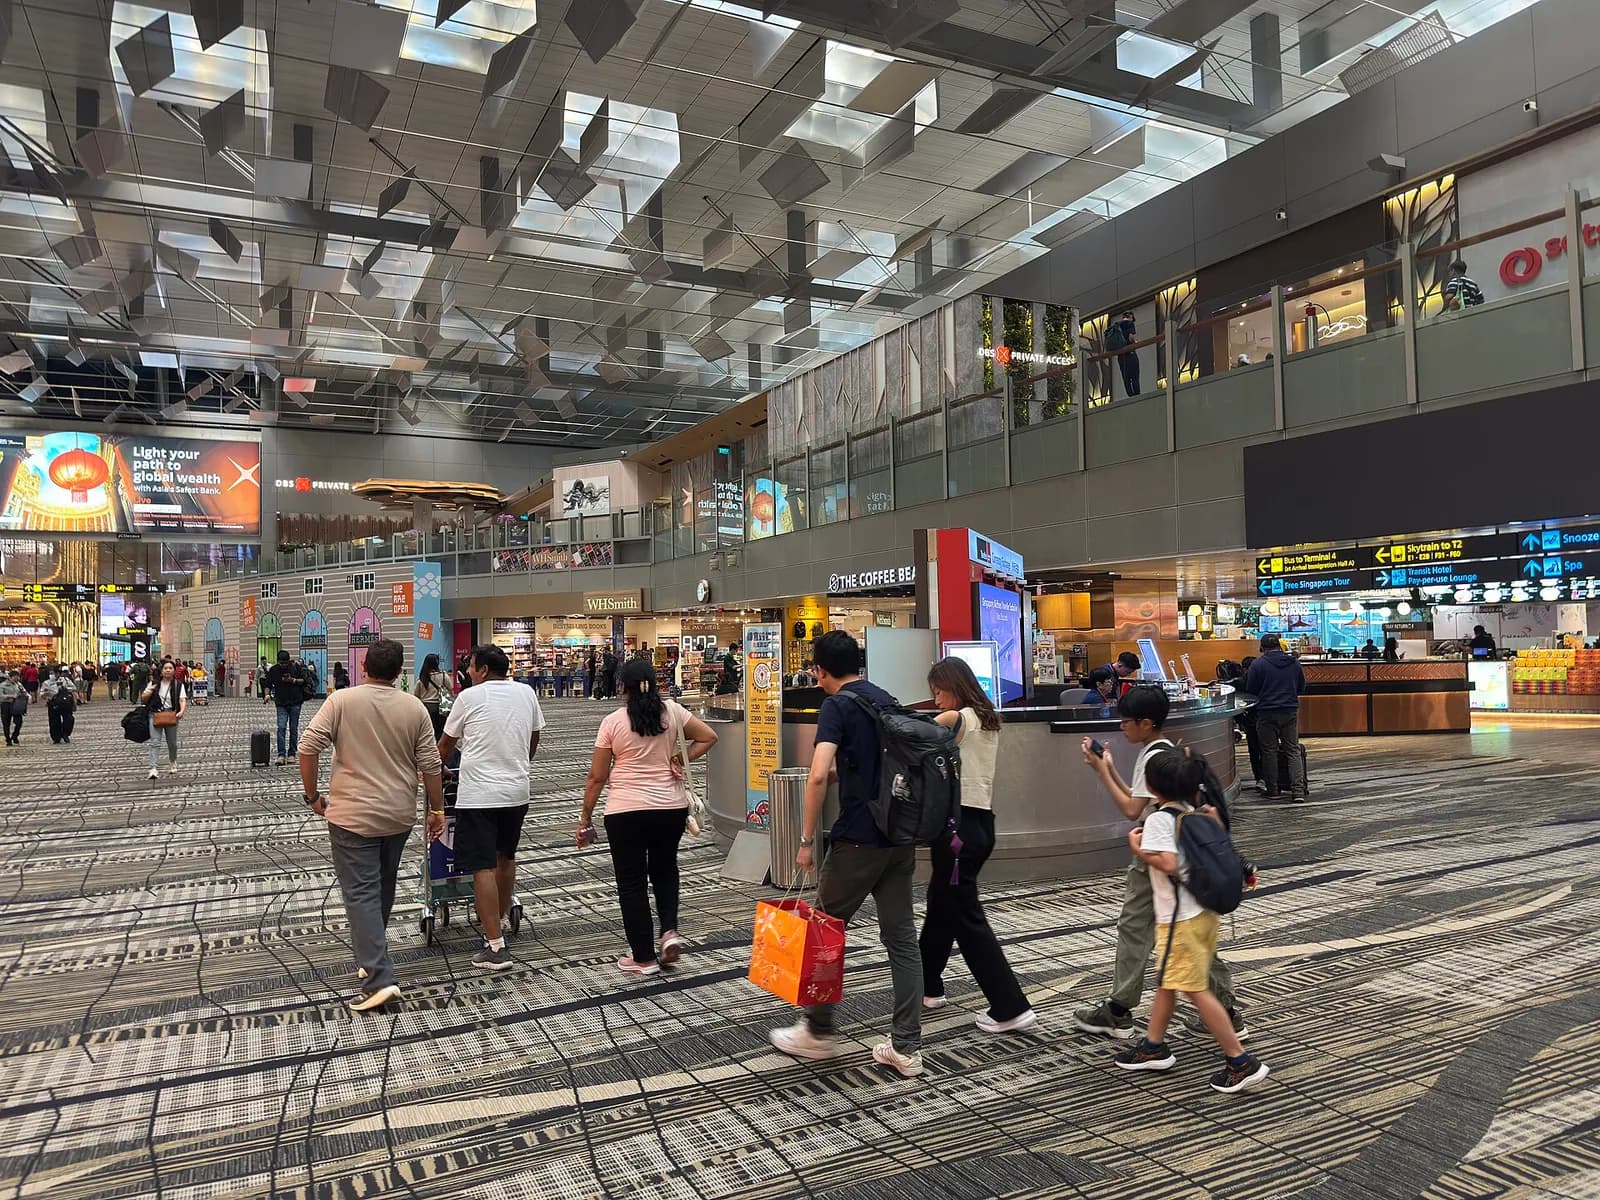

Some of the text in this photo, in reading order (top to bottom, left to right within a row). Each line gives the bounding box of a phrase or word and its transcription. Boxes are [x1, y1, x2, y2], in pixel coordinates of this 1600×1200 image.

[977, 347, 1076, 366] DBS PRIVATE ACCESS
[133, 446, 200, 460] Light your
[133, 460, 181, 471] path to
[133, 471, 221, 484] global wealth
[133, 485, 151, 493] with
[175, 486, 199, 494] Safest
[200, 487, 221, 495] Bank.
[275, 480, 349, 490] DBS PRIVATE
[1562, 532, 1600, 544] Snooze
[1407, 540, 1463, 554] Skytrain to T2
[532, 552, 568, 563] WHSmith
[1284, 557, 1295, 565] Bus
[1303, 552, 1331, 562] Terminal
[1331, 552, 1337, 560] 4
[1408, 565, 1452, 576] Transit Hotel
[1564, 561, 1583, 573] Spa
[839, 574, 857, 589] THE
[859, 568, 896, 587] COFFEE
[1284, 577, 1350, 590] Free Singapore Tour
[1408, 573, 1478, 586] Pay-per-use Lounge
[587, 597, 637, 610] WHSmith
[494, 620, 535, 629] READING
